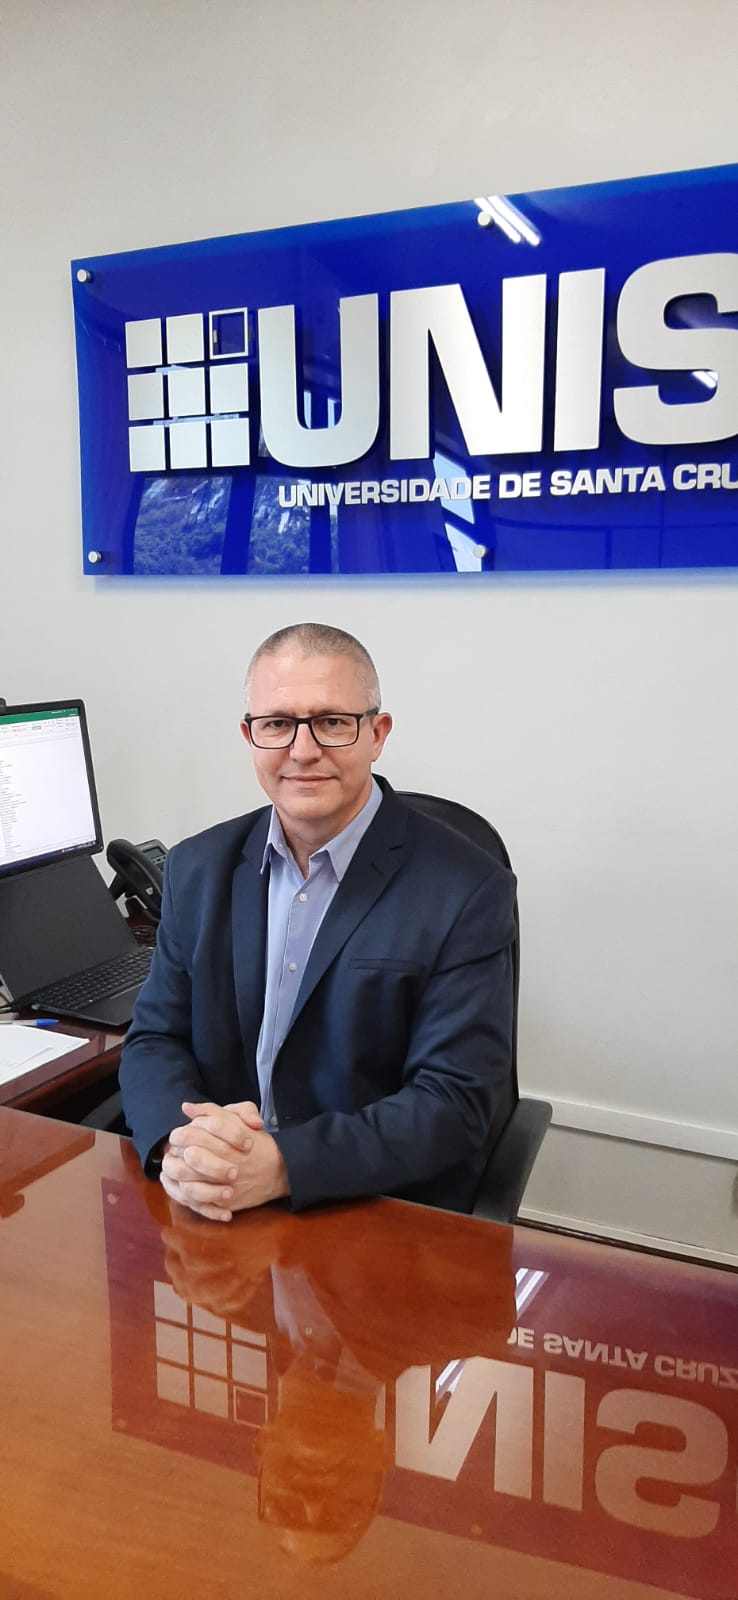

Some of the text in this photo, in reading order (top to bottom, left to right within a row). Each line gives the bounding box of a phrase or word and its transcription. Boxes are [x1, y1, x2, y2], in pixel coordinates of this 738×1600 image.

[278, 474, 491, 508] UNIVERSIDADE
[498, 472, 542, 499] DE
[549, 466, 666, 496] SANTA
